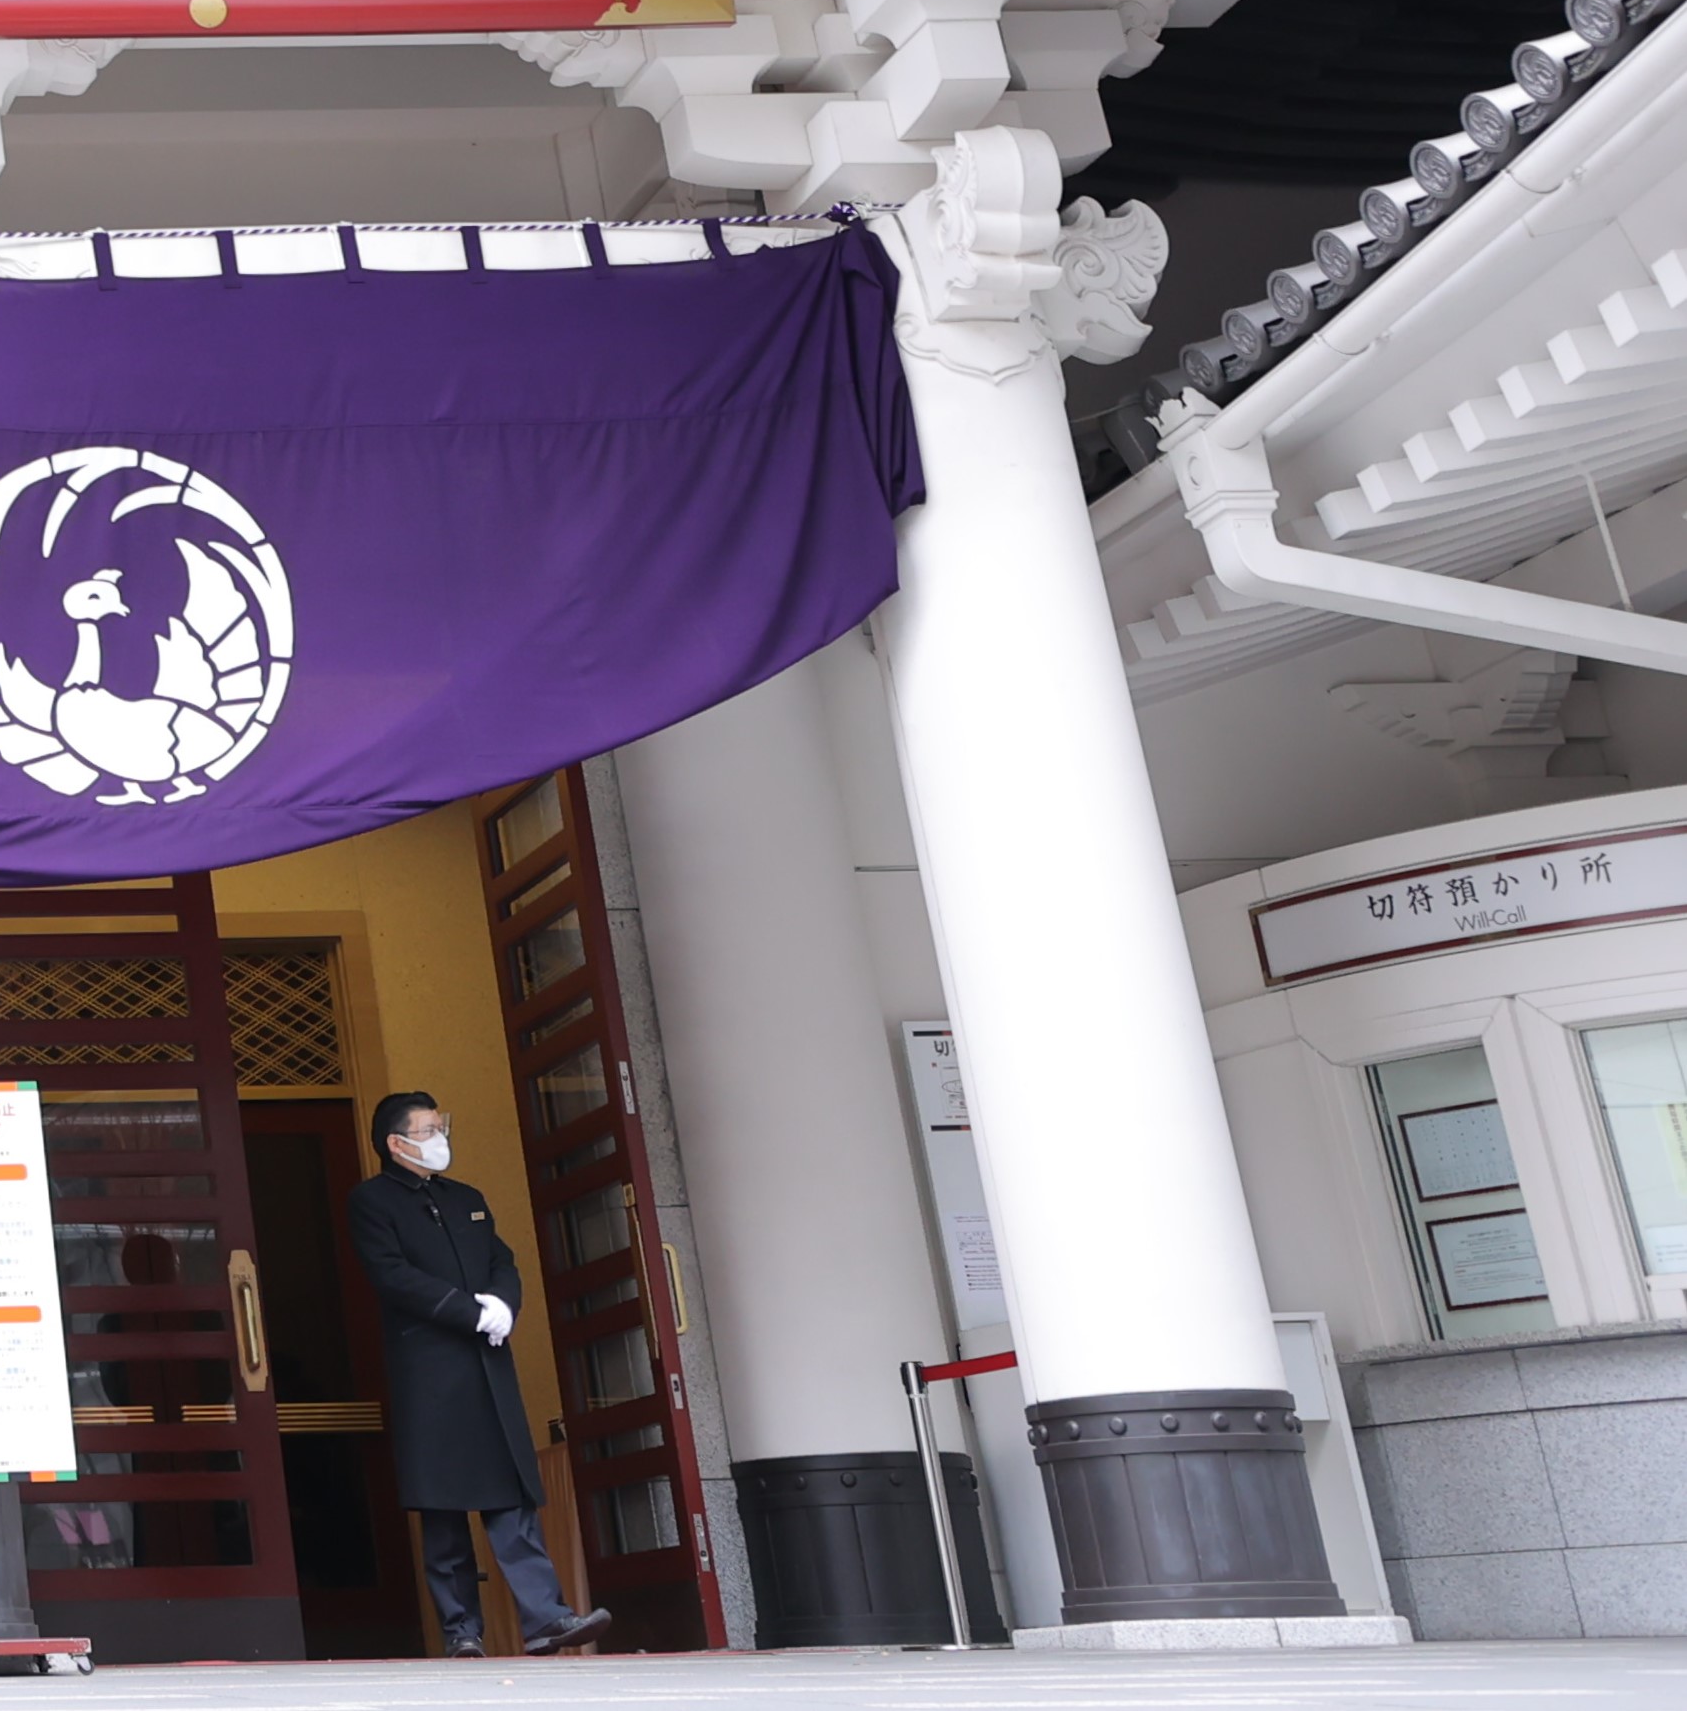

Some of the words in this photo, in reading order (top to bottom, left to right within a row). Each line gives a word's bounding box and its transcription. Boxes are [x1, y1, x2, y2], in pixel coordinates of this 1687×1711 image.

[1367, 852, 1613, 921] 切符預かり所
[1454, 905, 1528, 932] Will-Call
